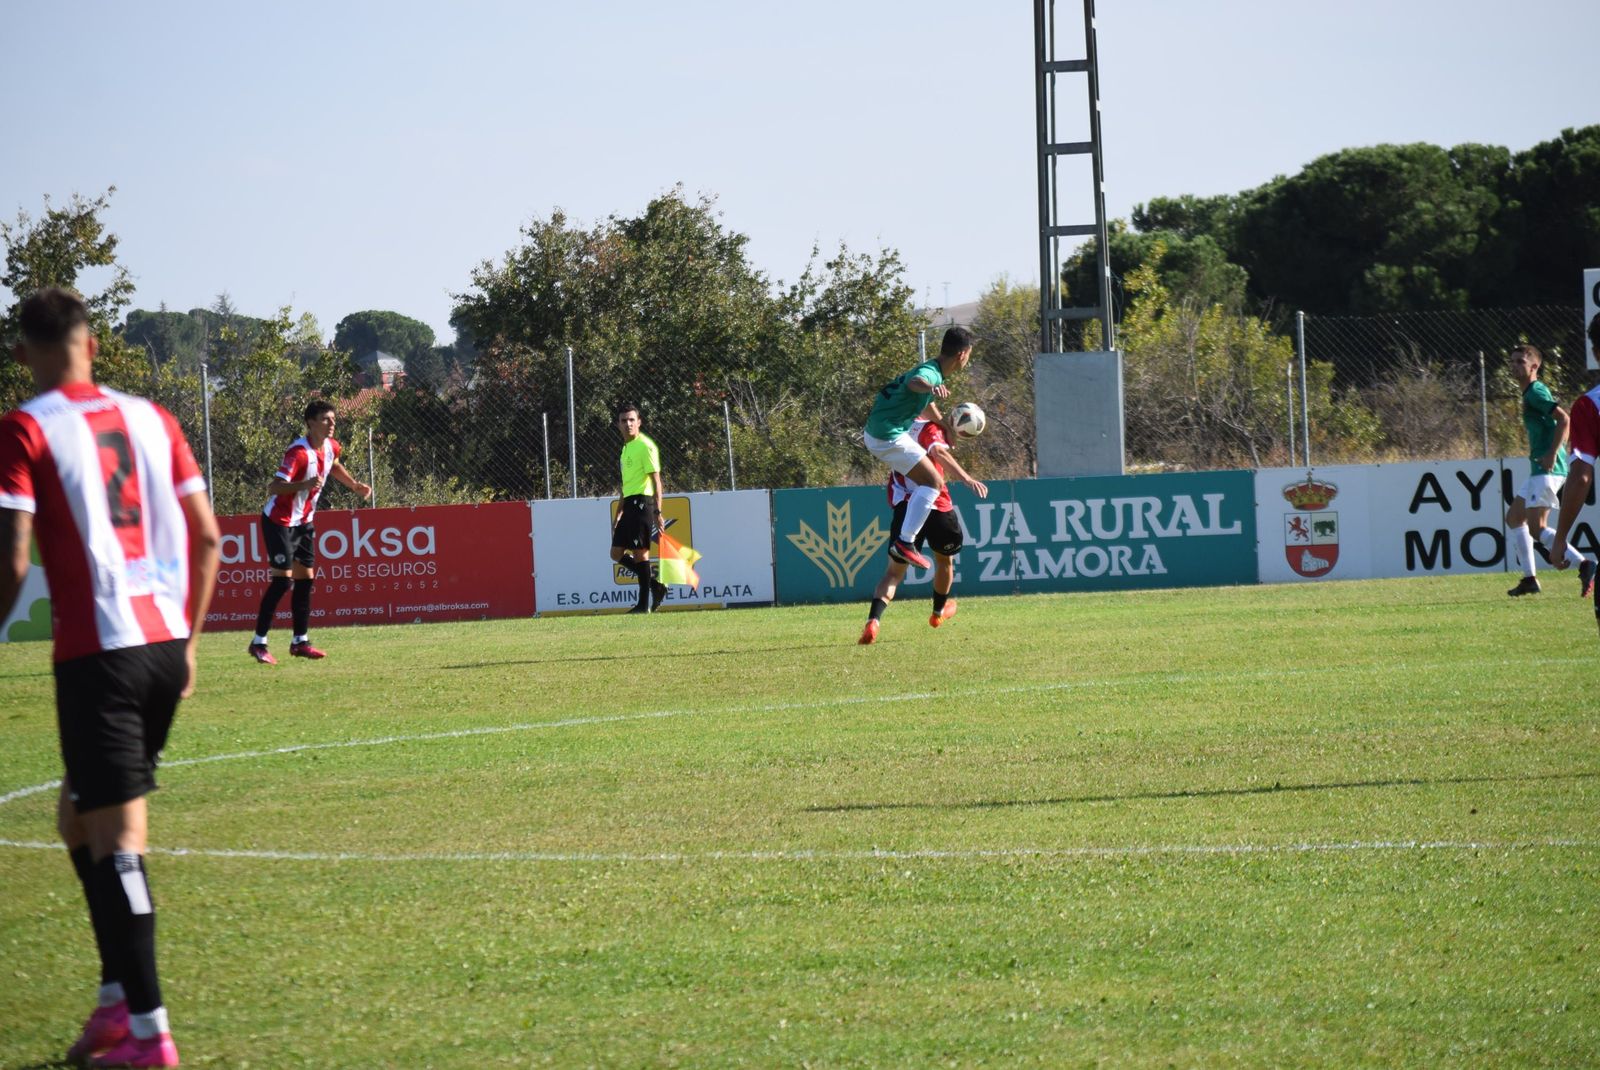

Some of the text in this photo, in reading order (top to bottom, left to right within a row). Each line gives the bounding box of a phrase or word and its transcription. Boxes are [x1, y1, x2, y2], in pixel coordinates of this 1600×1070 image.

[96, 431, 141, 527] 2
[922, 492, 1243, 549] AJA RURAL
[217, 518, 436, 564] aloksa
[216, 561, 437, 584] CORREA DE SEGUROS
[979, 543, 1168, 583] ZAMORA
[275, 611, 293, 620] 980
[335, 608, 351, 616] 670
[353, 607, 367, 615] 752
[369, 606, 384, 615] 795
[395, 602, 489, 613] zamora@albroksa.com
[557, 592, 585, 605] E.S.
[589, 589, 638, 604] CAMIN
[680, 586, 699, 599] LA
[703, 584, 753, 598] PLATA
